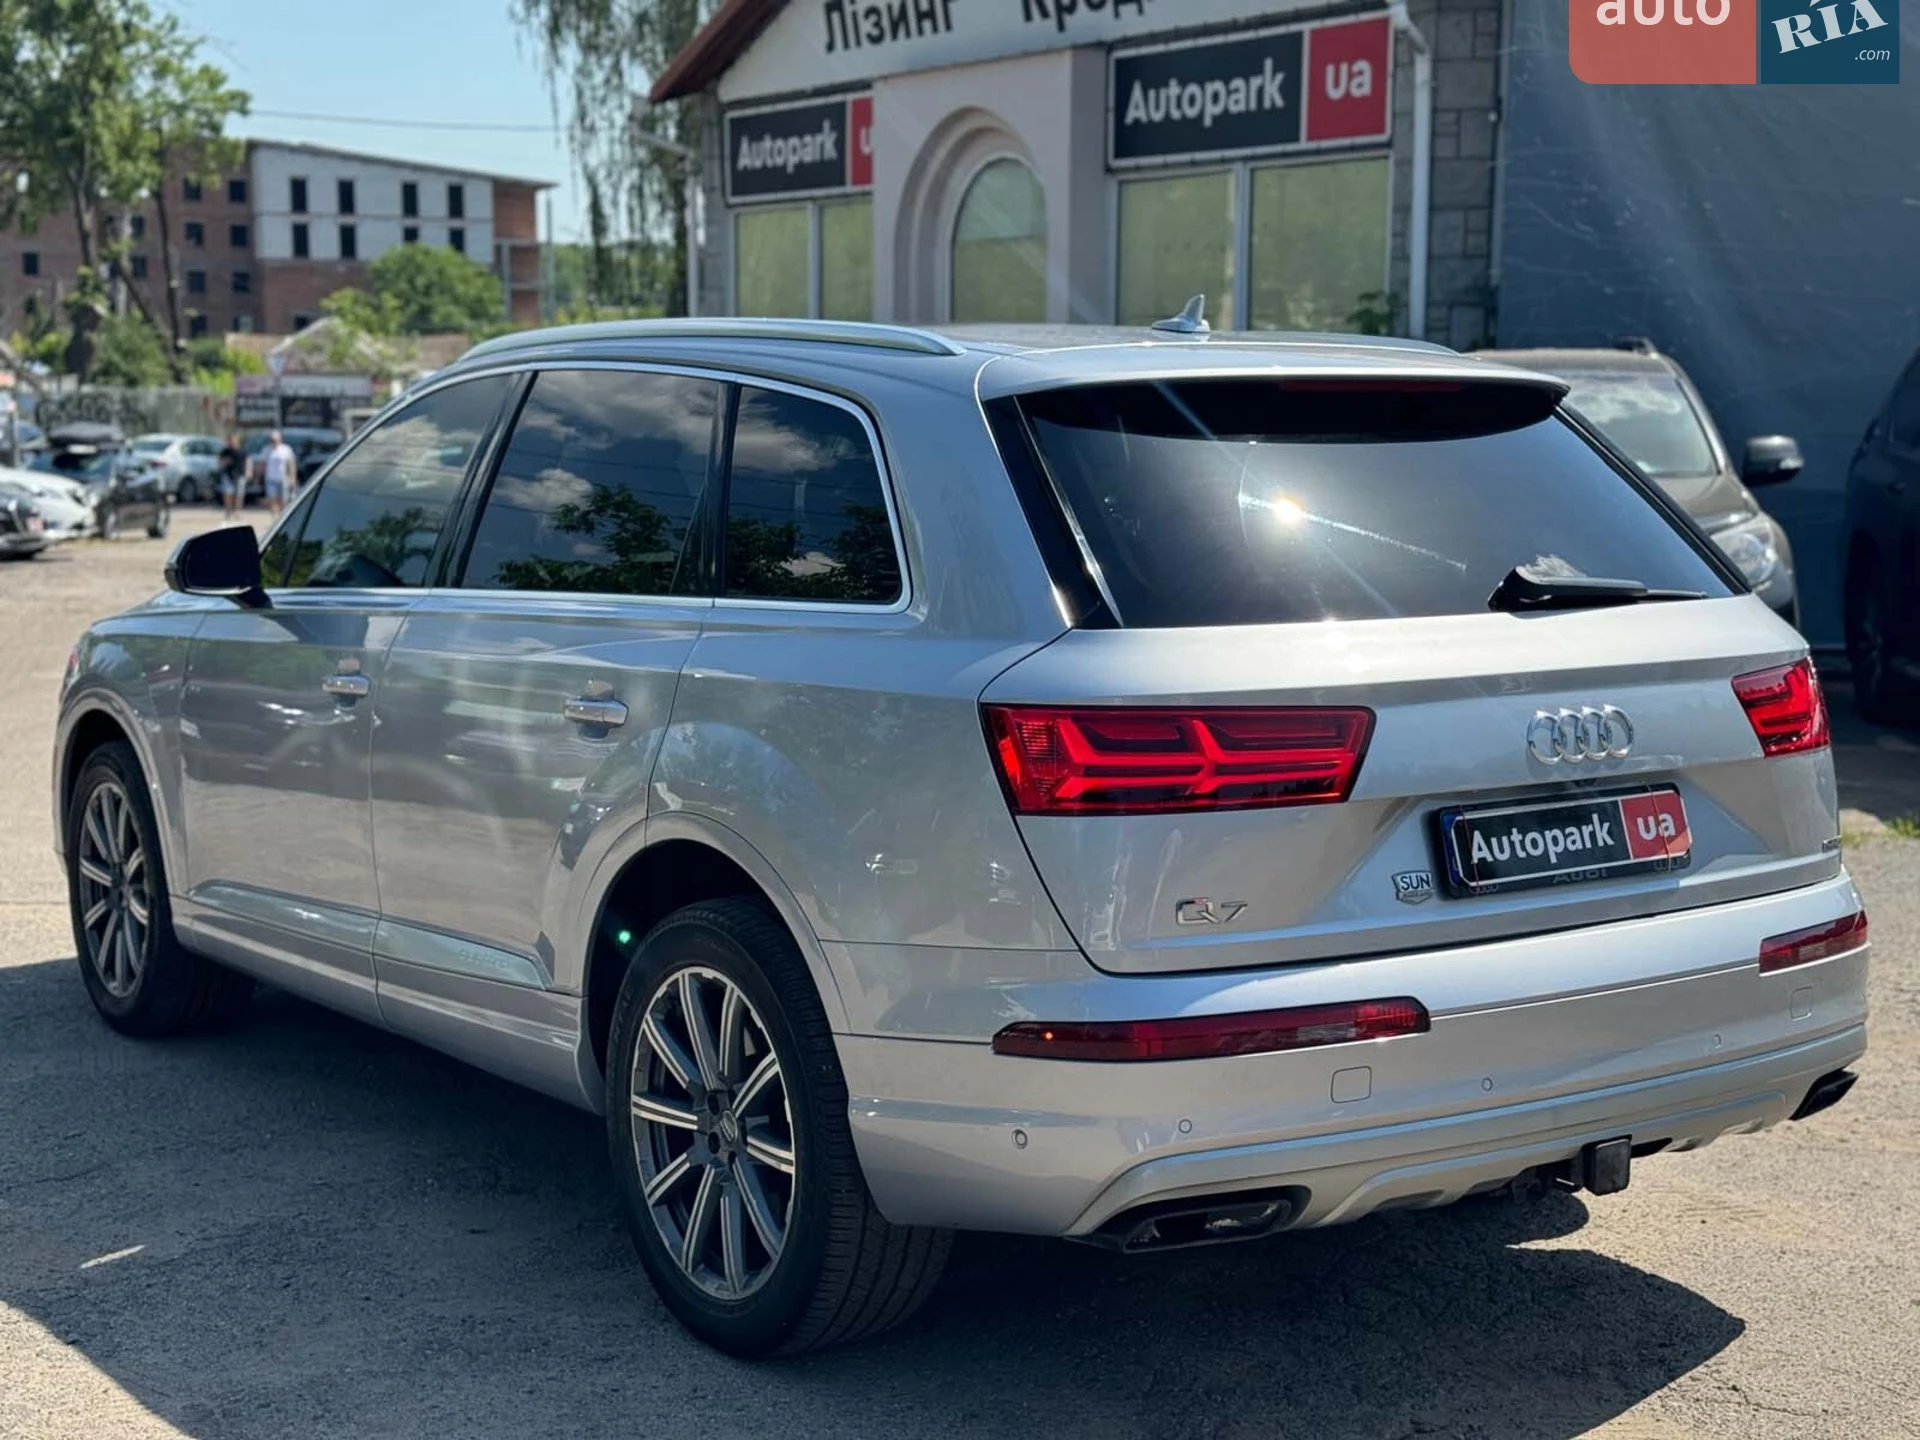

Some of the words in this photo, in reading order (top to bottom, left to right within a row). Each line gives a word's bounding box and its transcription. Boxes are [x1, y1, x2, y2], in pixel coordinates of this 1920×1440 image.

[1124, 57, 1286, 128] Autopark
[1325, 58, 1373, 100] ua
[736, 118, 838, 174] Autopark
[1471, 813, 1615, 864] Autopark
[1636, 812, 1676, 841] ua
[1400, 874, 1431, 891] SUN
[1176, 897, 1248, 926] Q7
